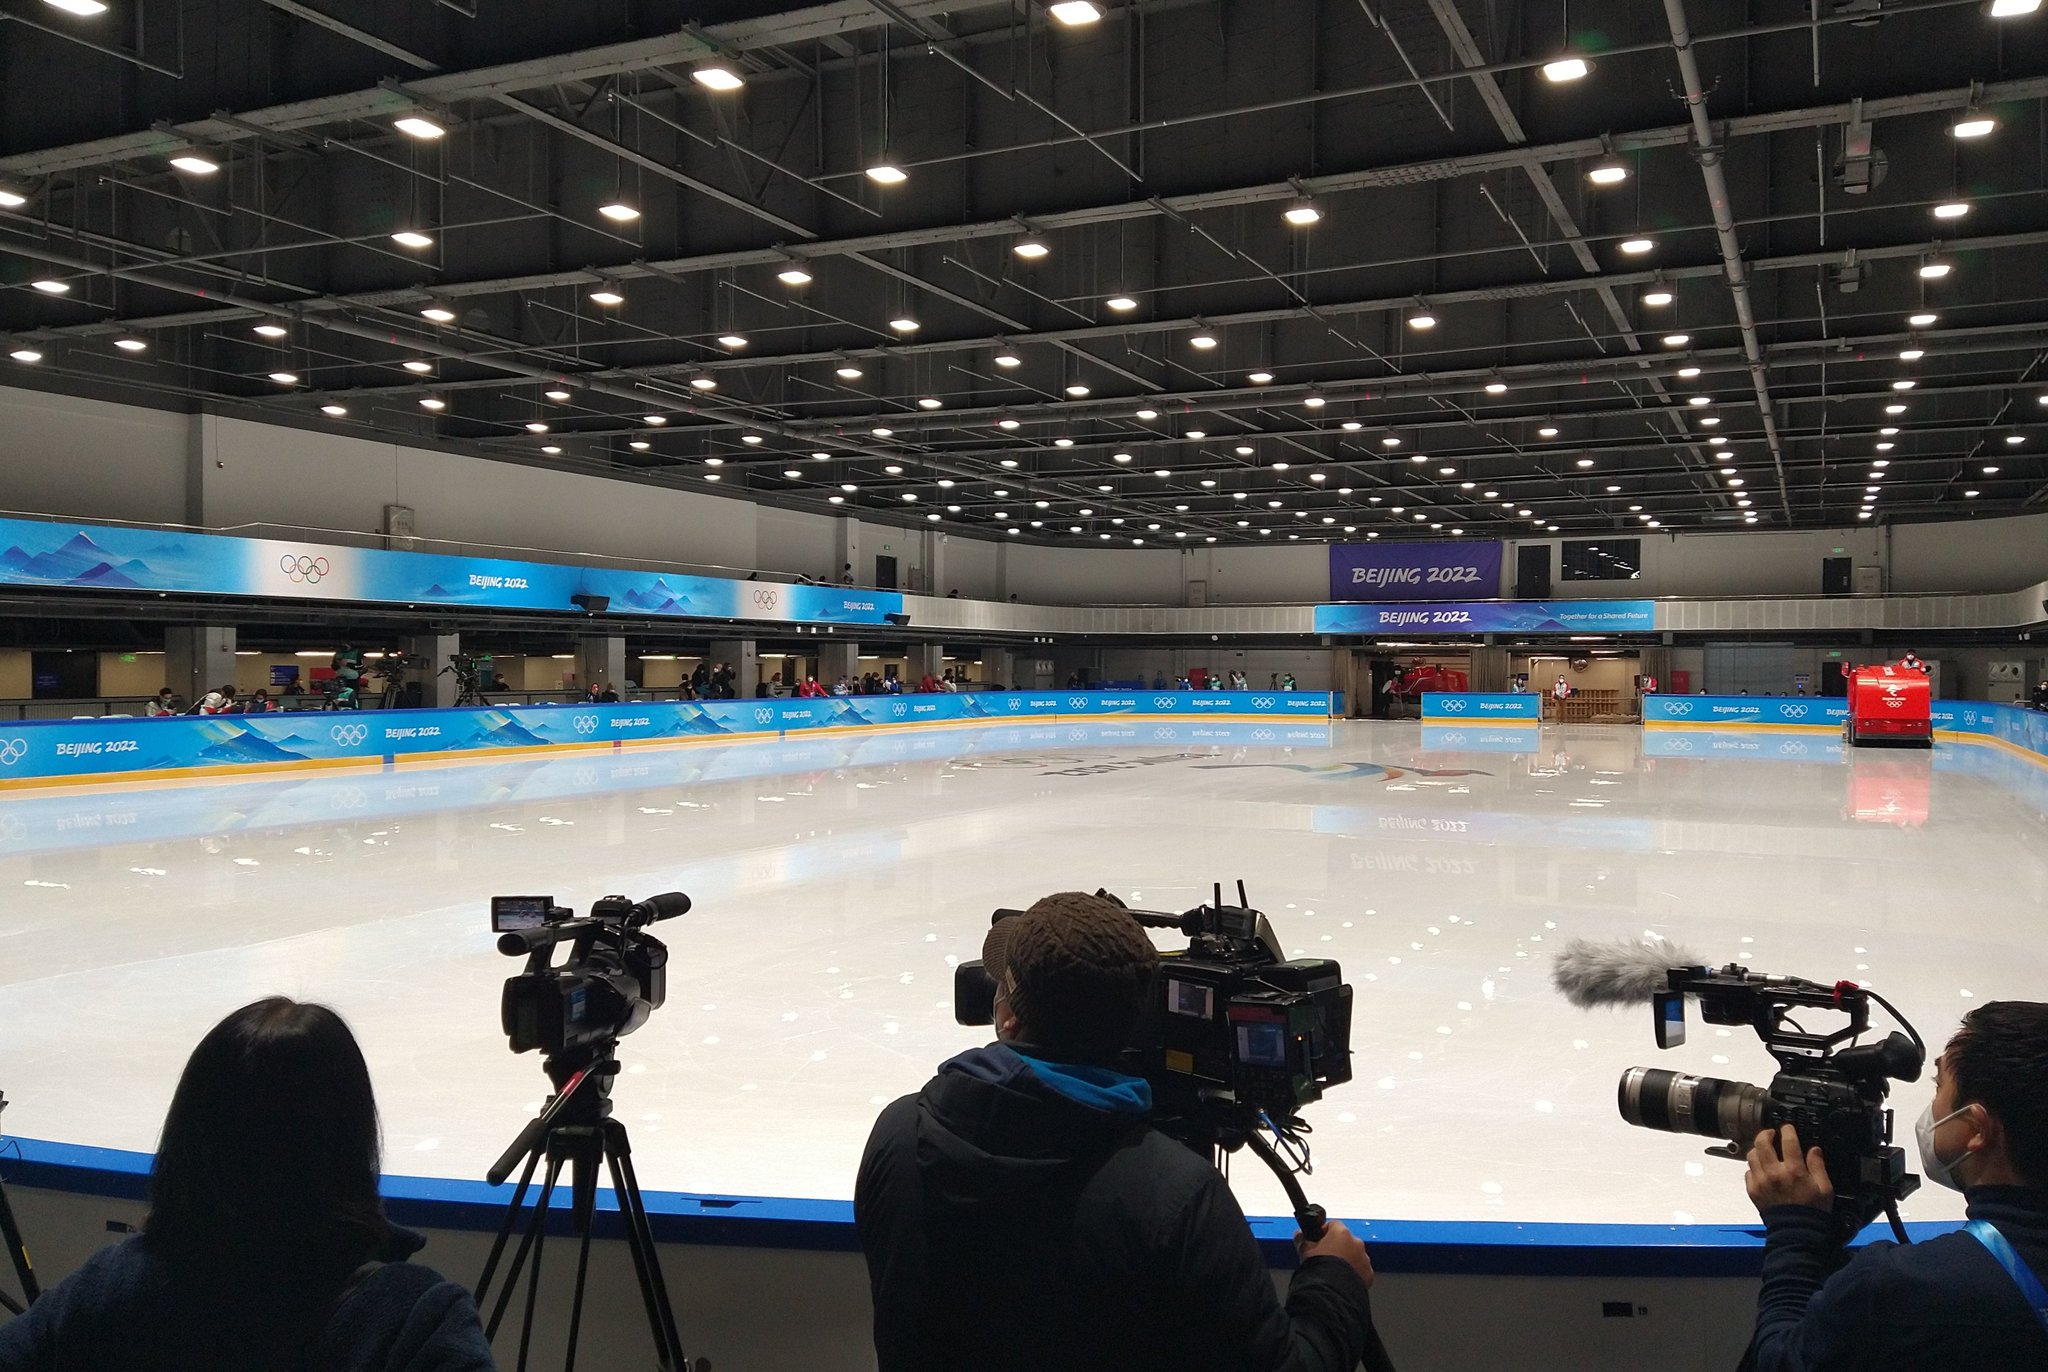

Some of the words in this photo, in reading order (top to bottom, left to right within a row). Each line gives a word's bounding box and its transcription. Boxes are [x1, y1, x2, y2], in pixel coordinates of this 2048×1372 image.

[469, 574, 502, 589] BEIJING
[504, 577, 528, 589] 2022
[1352, 567, 1421, 588] BEIJING
[1427, 566, 1482, 583] 2022
[1379, 611, 1429, 627] BEIJING
[1432, 611, 1472, 623] 2022
[1560, 613, 1588, 621] Together
[1479, 702, 1504, 711] BEIJING
[1712, 706, 1739, 714] BEIJING
[610, 718, 633, 729] BEIJING
[385, 728, 417, 740] BEIJING
[418, 726, 441, 737] 2022
[56, 742, 102, 757] BEIJING
[105, 740, 139, 752] 2022
